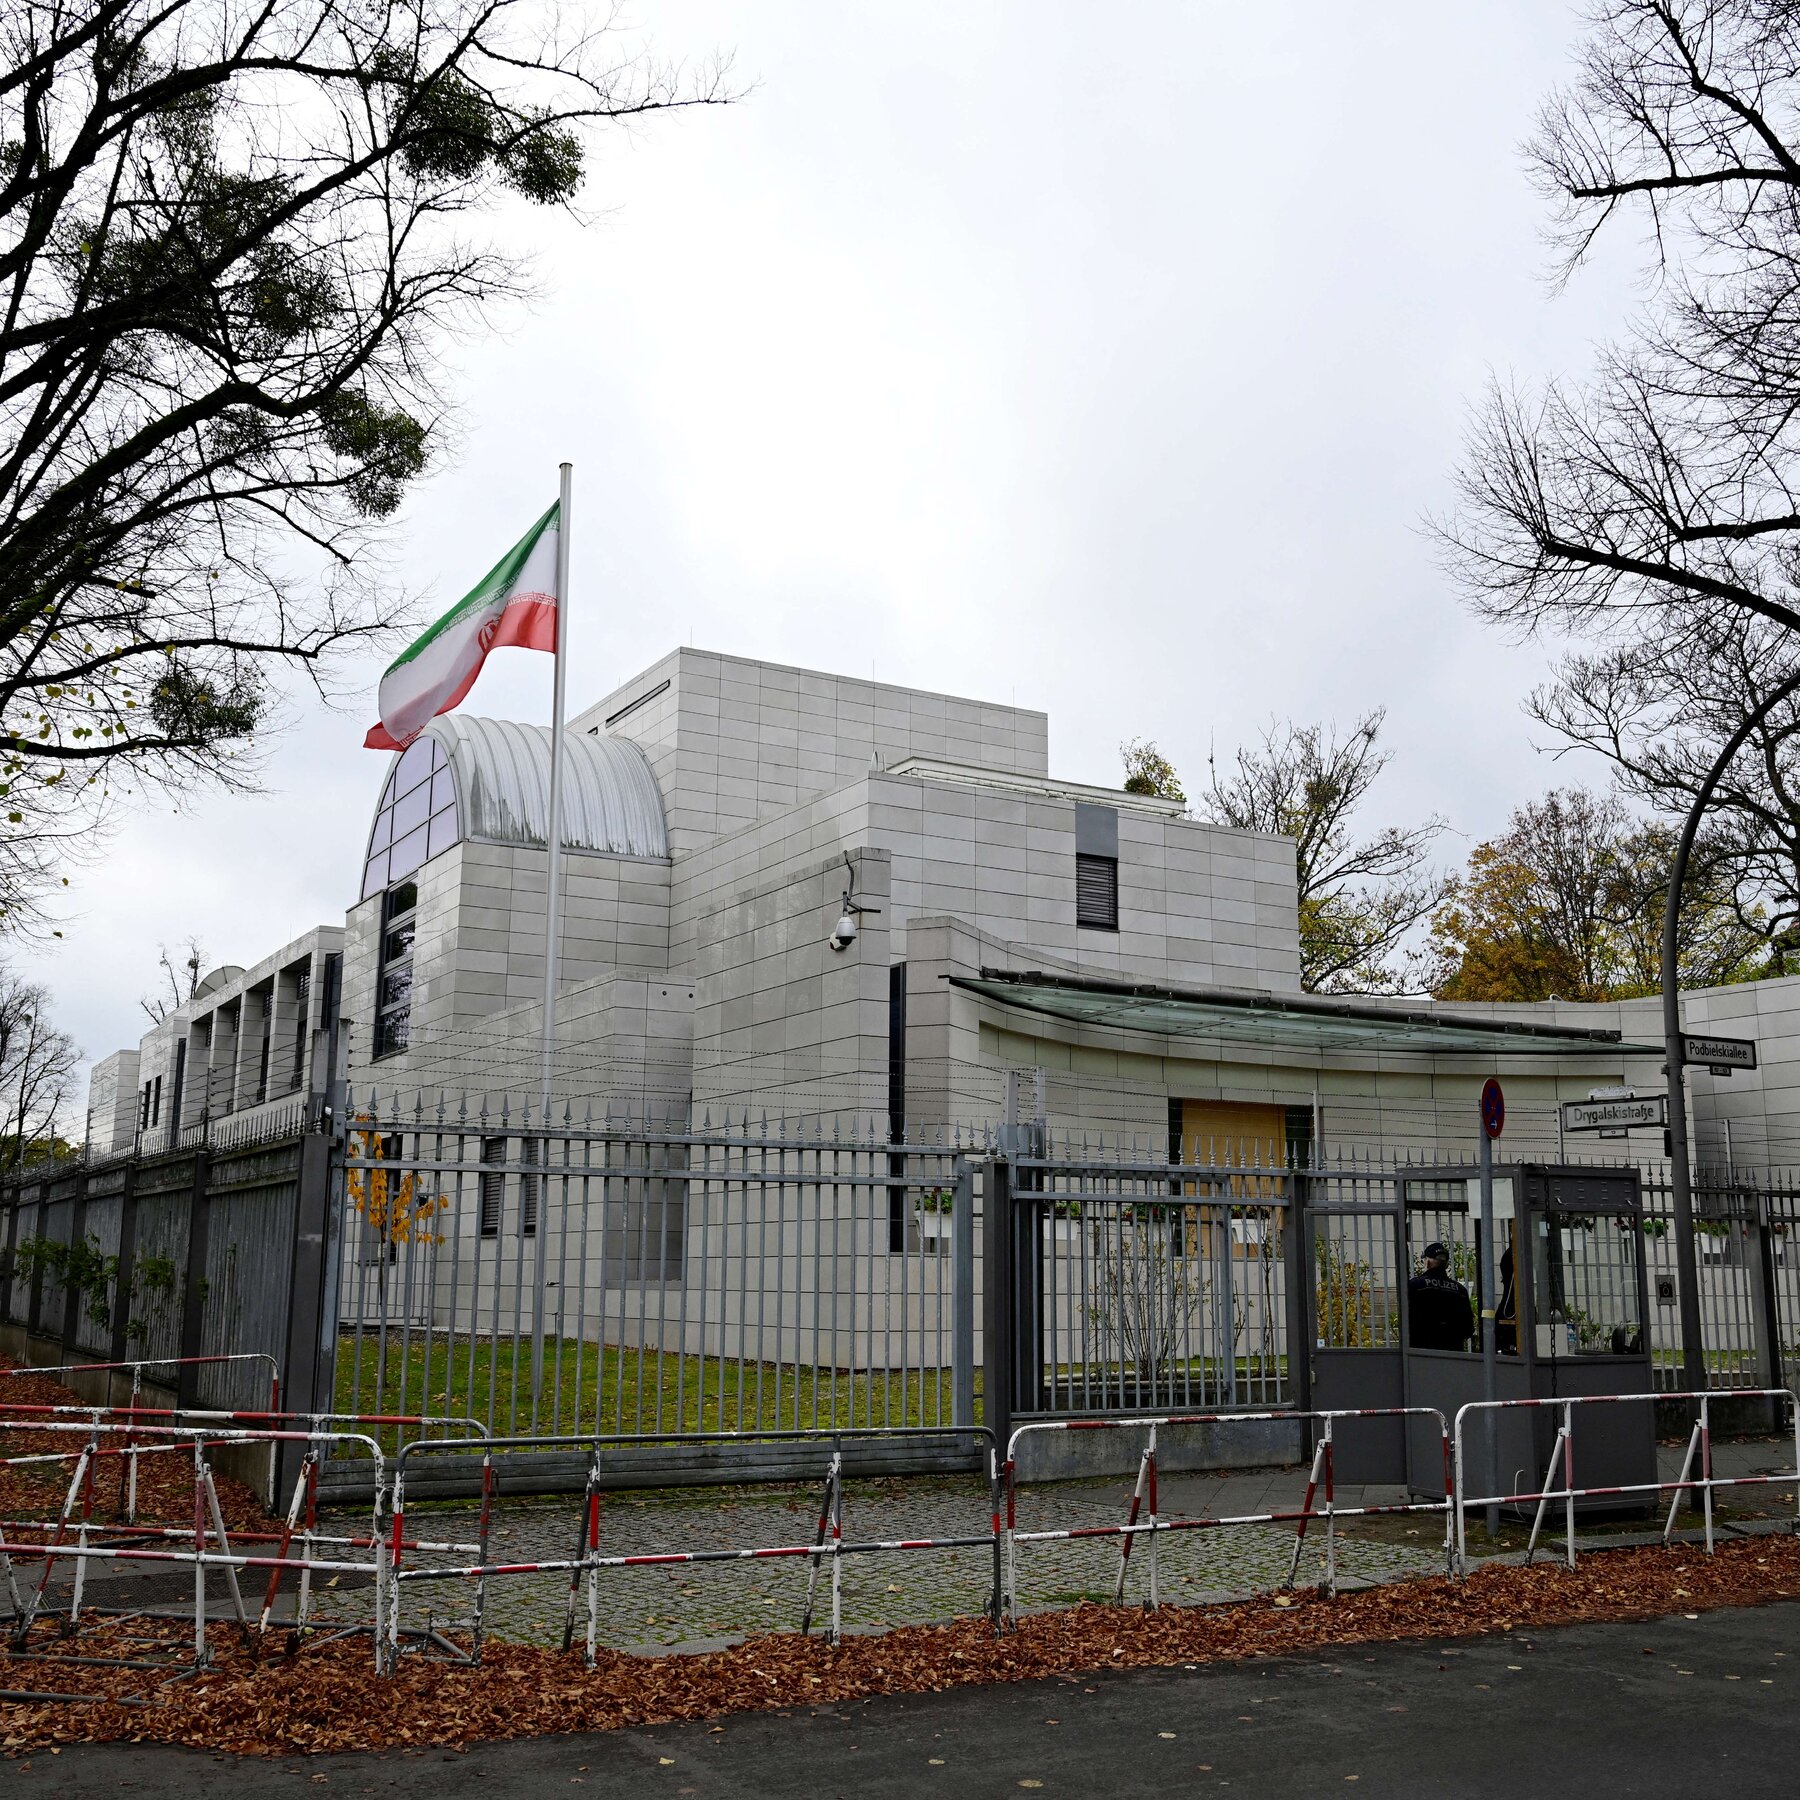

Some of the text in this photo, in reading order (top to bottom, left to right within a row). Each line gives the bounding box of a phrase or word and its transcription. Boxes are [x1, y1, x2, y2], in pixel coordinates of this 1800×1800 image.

[1689, 1041, 1748, 1059] Podbielskiallee
[1574, 1104, 1654, 1124] Drygalskistraße
[1425, 1278, 1459, 1291] POLIZEI
